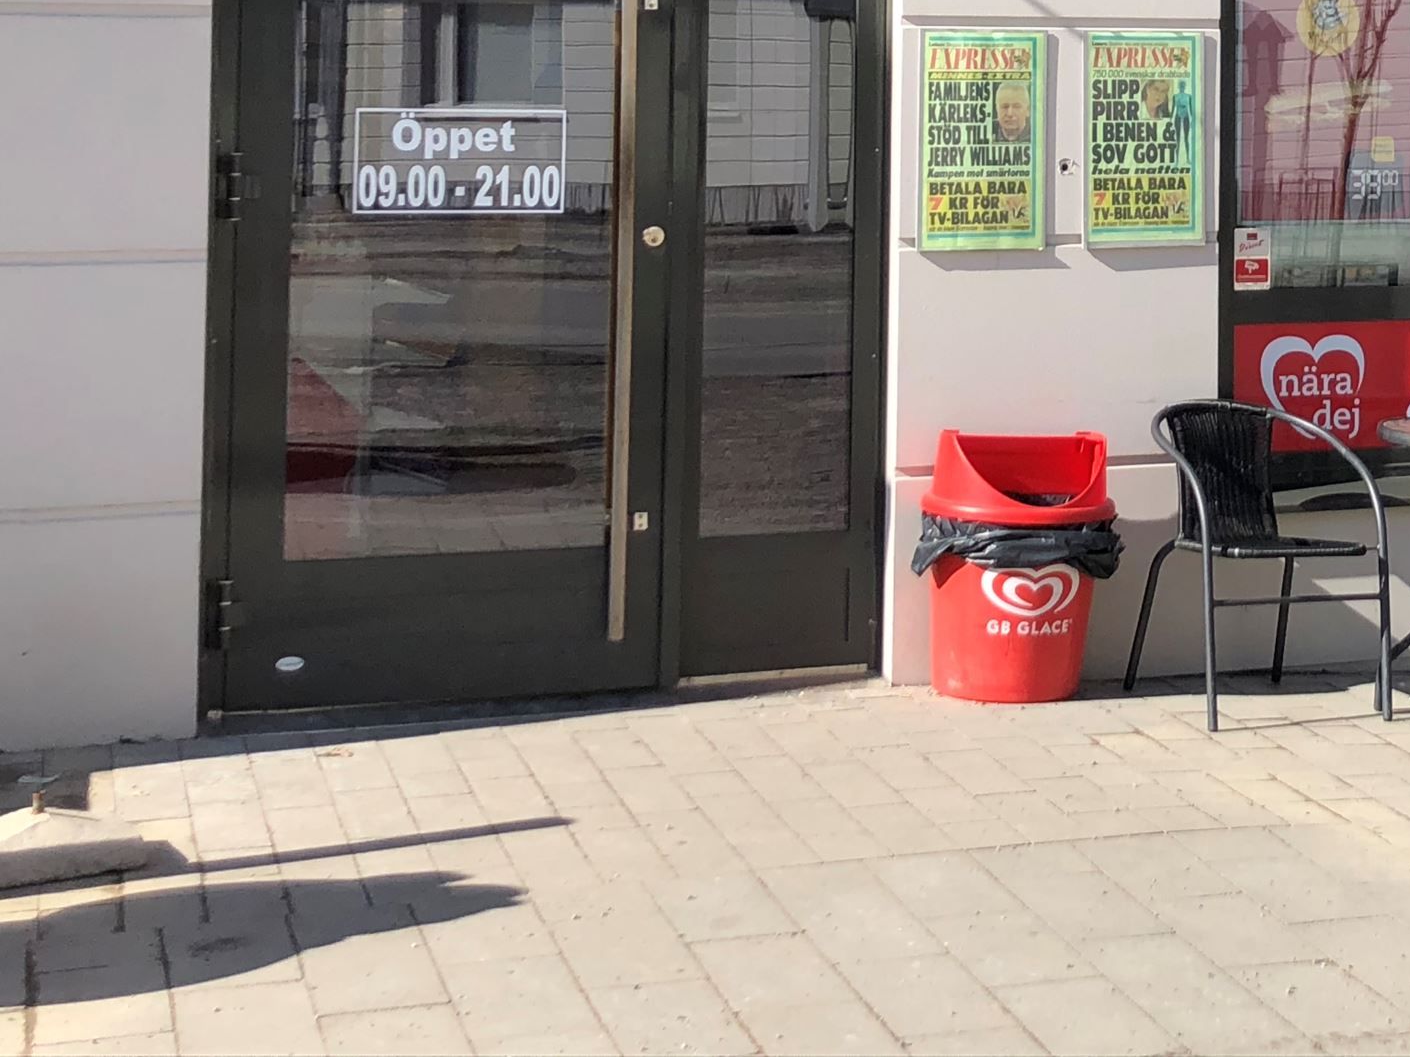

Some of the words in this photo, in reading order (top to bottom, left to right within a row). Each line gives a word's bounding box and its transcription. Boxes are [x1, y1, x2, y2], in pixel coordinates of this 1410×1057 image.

[928, 82, 991, 101] FAMILJENS
[1092, 79, 1140, 100] SLIPP
[928, 102, 991, 123] KÄRLEKS-
[1092, 101, 1140, 121] PIRR
[392, 111, 516, 159] Öppet
[928, 124, 961, 145] STÖD
[967, 125, 990, 145] TILL
[1092, 122, 1097, 142] I
[1103, 122, 1157, 142] BENEN
[1163, 122, 1176, 142] &
[928, 146, 966, 166] JERRY
[970, 145, 1031, 166] WILLIAMS
[1092, 143, 1128, 164] SOV
[1133, 143, 1177, 164] GOTT
[927, 168, 965, 180] Kampen
[1091, 165, 1130, 175] hela
[1134, 165, 1191, 175] natten
[359, 164, 446, 208] 09.00
[473, 164, 560, 208] 21.00
[929, 182, 982, 195] BETALA
[987, 181, 1027, 194] BARA
[1093, 177, 1143, 191] BETALA
[1148, 177, 1186, 190] BARA
[929, 197, 943, 211] 7
[949, 197, 968, 210] KR
[973, 196, 999, 209] FÖR
[1093, 192, 1106, 206] 7
[1112, 192, 1130, 205] KR
[1135, 191, 1160, 204] FÖR
[929, 211, 1009, 225] TV-BILAGAN
[1093, 206, 1169, 220] TV-BILAGAN
[1279, 366, 1353, 398] nära
[1312, 397, 1360, 439] dej
[986, 619, 1011, 635] GB
[1017, 619, 1070, 635] GLACE
